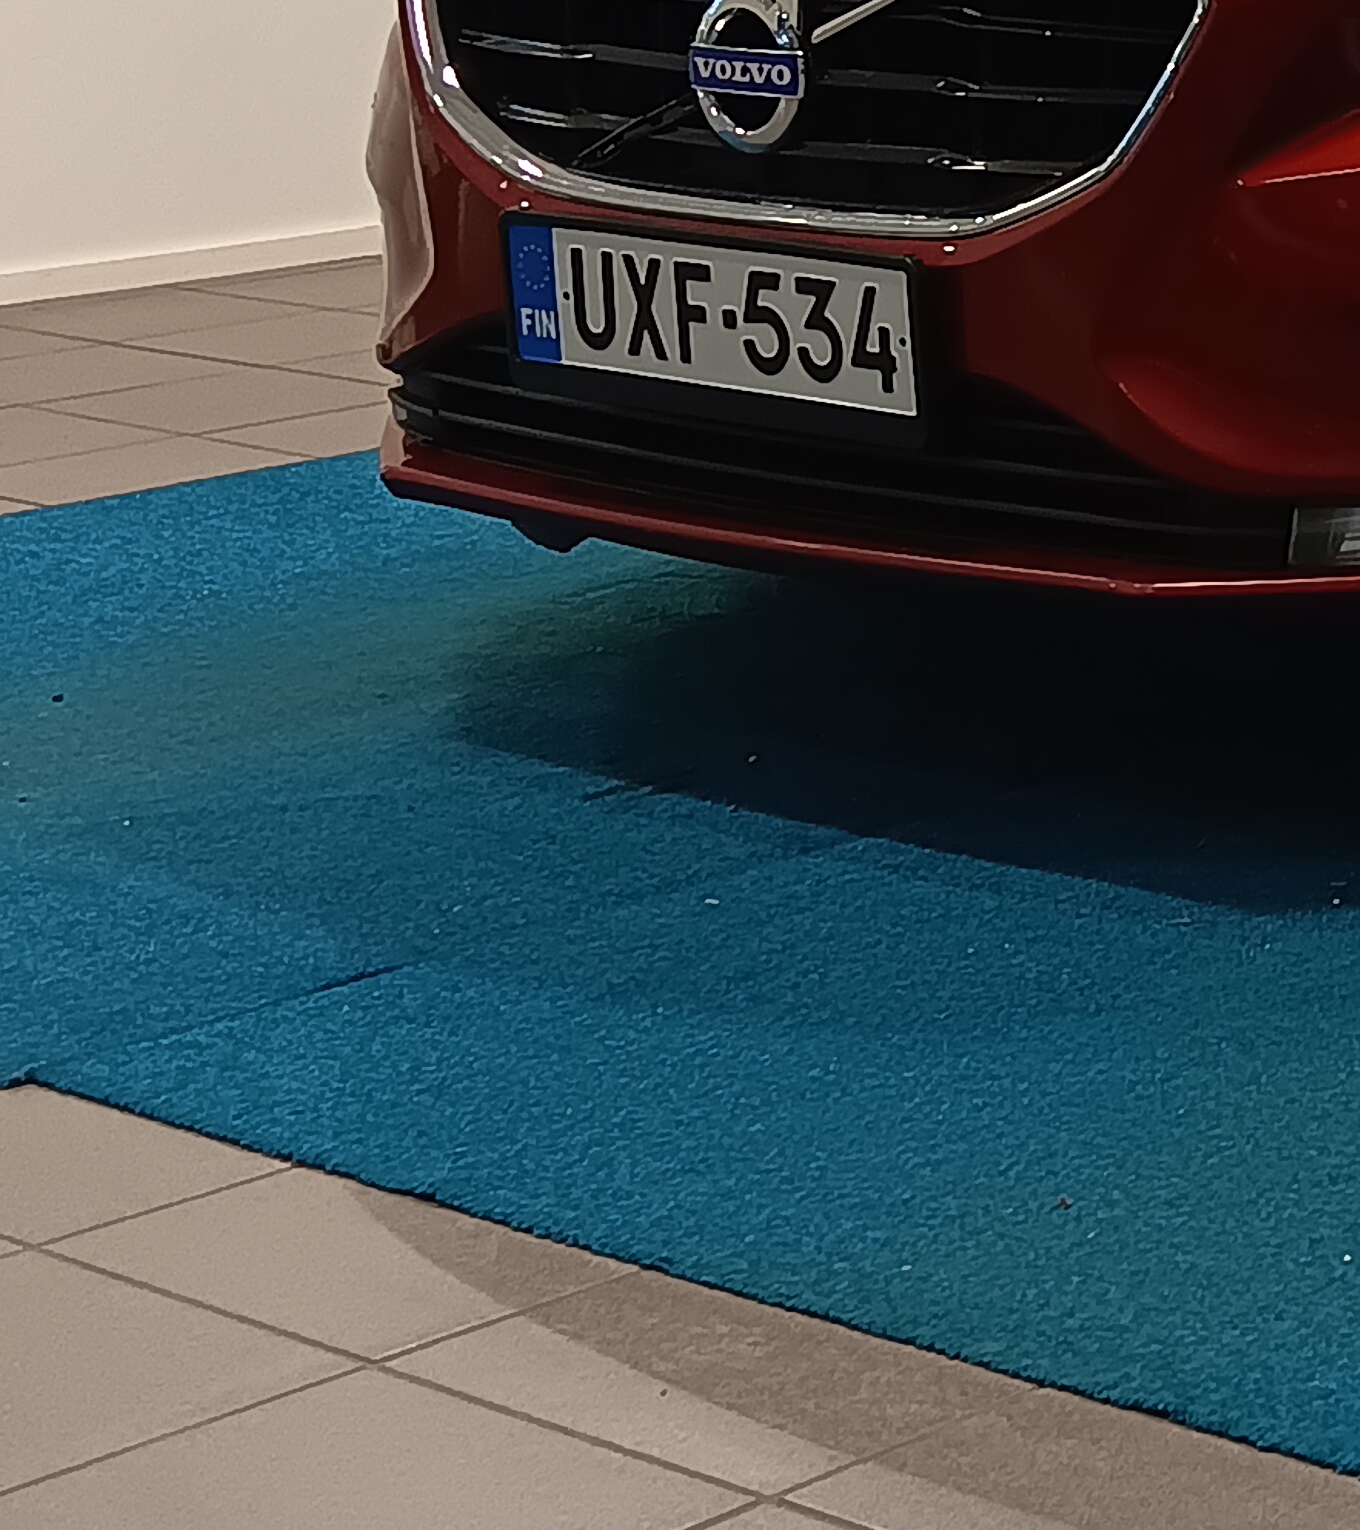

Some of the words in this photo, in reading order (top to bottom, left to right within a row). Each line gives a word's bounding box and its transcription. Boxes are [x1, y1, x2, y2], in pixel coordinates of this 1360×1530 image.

[694, 55, 792, 86] VOLVO
[520, 307, 557, 340] FIN
[570, 246, 897, 393] UXF-534
